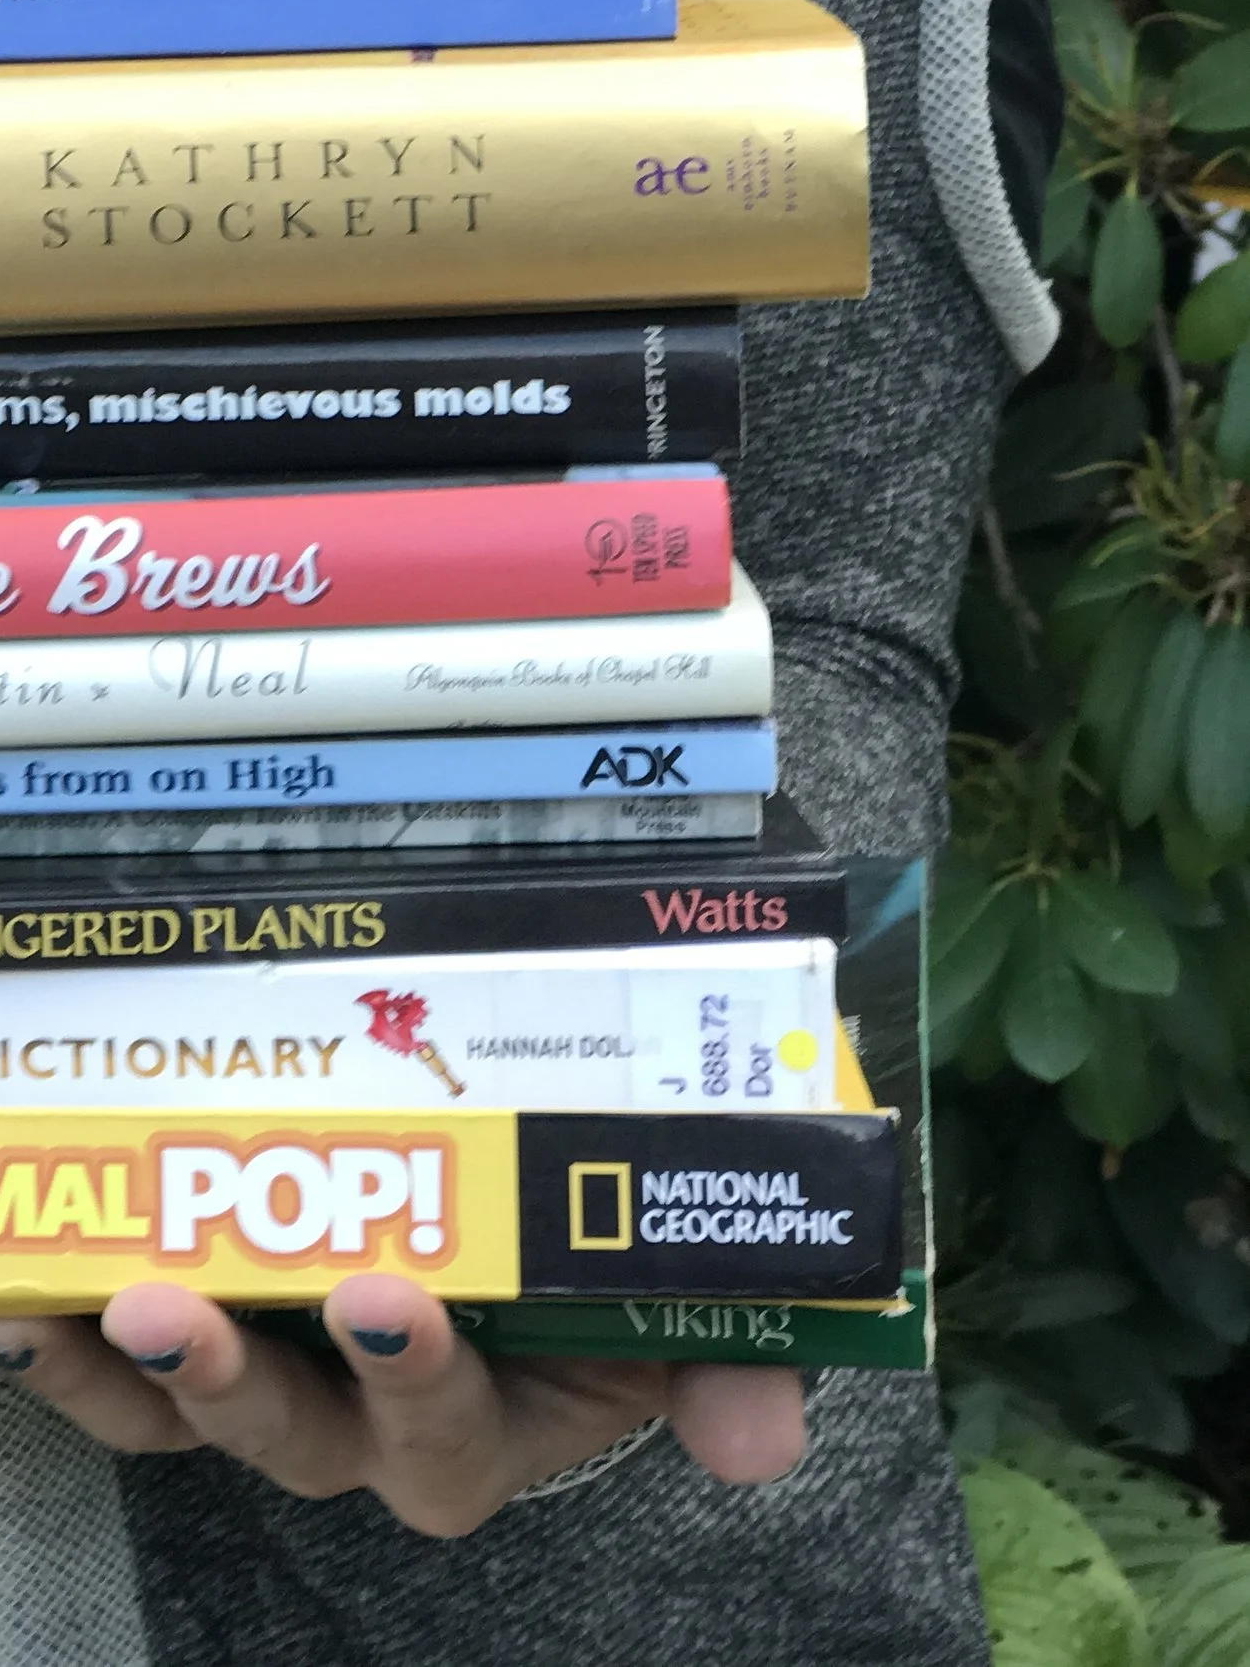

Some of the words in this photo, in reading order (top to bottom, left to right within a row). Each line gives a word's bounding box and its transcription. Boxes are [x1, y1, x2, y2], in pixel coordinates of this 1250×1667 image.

[41, 133, 485, 191] KATHRYN
[42, 192, 492, 249] STOCKETT
[88, 385, 401, 425] mischievous
[414, 379, 571, 417] molds
[47, 515, 331, 617] Brews
[150, 637, 312, 701] Neal
[22, 760, 130, 797] from
[150, 765, 208, 794] on
[226, 754, 336, 799] High
[581, 744, 689, 790] ADK
[191, 901, 388, 953] PLANTS
[641, 889, 789, 935] Watts
[466, 1036, 572, 1060] HANNAH
[699, 993, 731, 1098] 688.72
[745, 1043, 774, 1098] Dor
[658, 1076, 689, 1095] J
[160, 1146, 444, 1256] POP!
[641, 1170, 809, 1207] NATIONAL
[639, 1209, 854, 1246] GEOGRAPHIC
[622, 1299, 795, 1351] Viking
